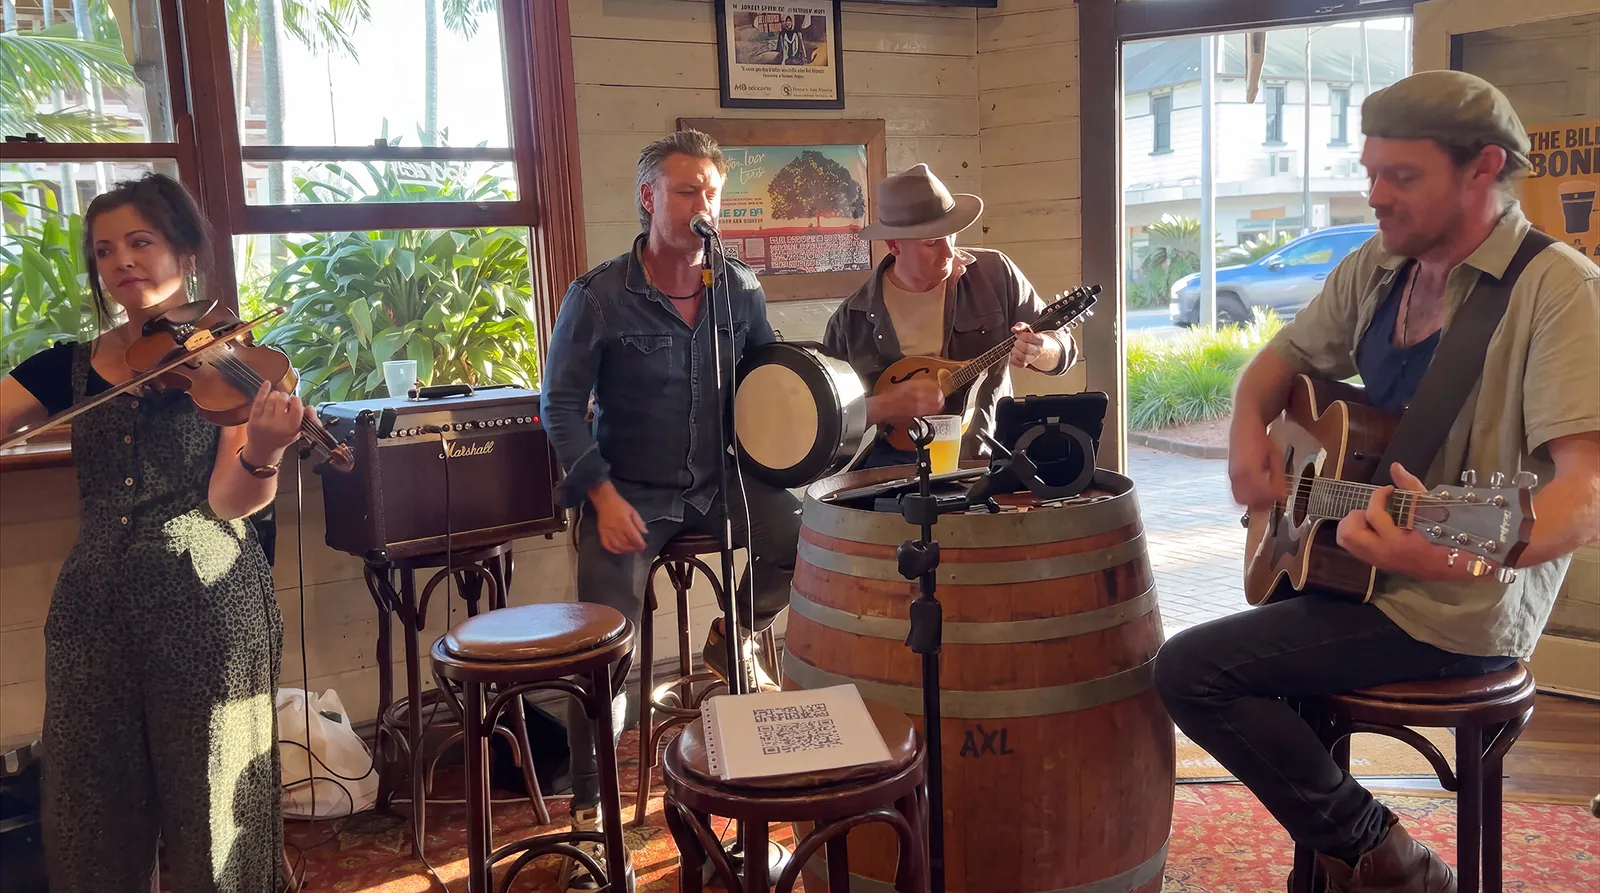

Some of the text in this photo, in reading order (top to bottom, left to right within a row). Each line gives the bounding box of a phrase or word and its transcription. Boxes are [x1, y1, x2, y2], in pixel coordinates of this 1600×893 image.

[1528, 131, 1560, 151] THE
[439, 440, 494, 459] Marshall
[960, 723, 1014, 758] AXL
